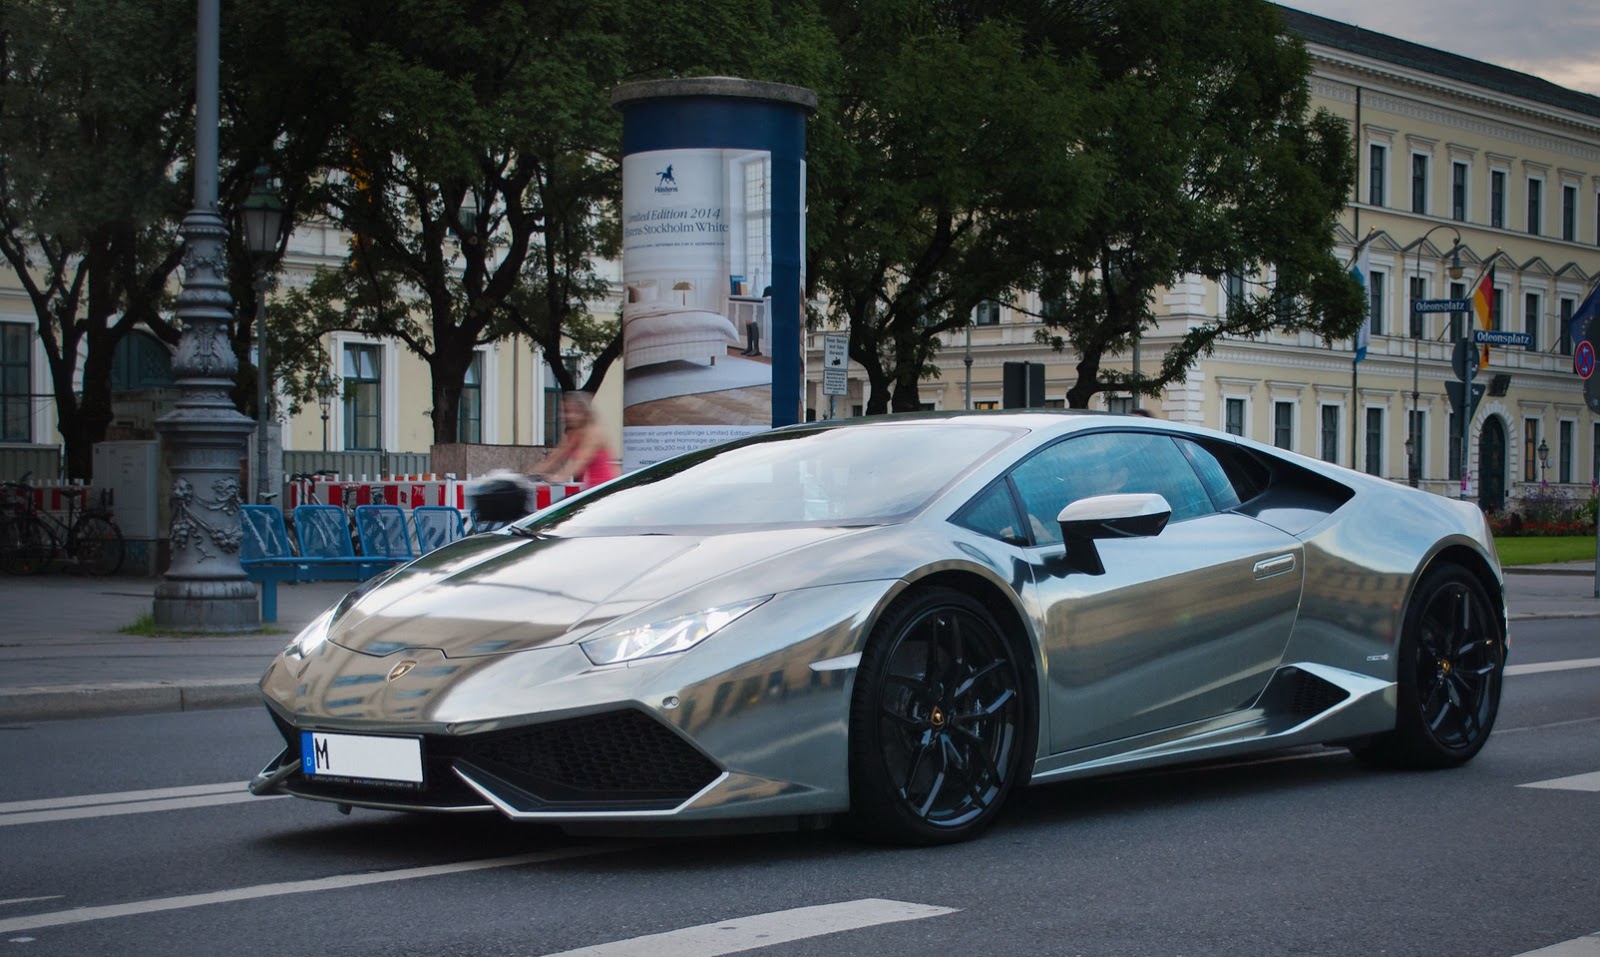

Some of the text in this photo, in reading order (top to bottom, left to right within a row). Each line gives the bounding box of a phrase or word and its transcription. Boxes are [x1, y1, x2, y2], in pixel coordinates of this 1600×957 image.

[651, 208, 688, 220] Edition
[690, 208, 721, 220] 2014
[643, 222, 694, 235] Stockholm
[695, 221, 729, 233] White
[1415, 301, 1465, 312] Odeonsplatz
[1477, 331, 1530, 344] Odeonsplatz
[673, 429, 705, 437] diesjährige
[314, 737, 330, 770] M
[306, 756, 312, 767] D
